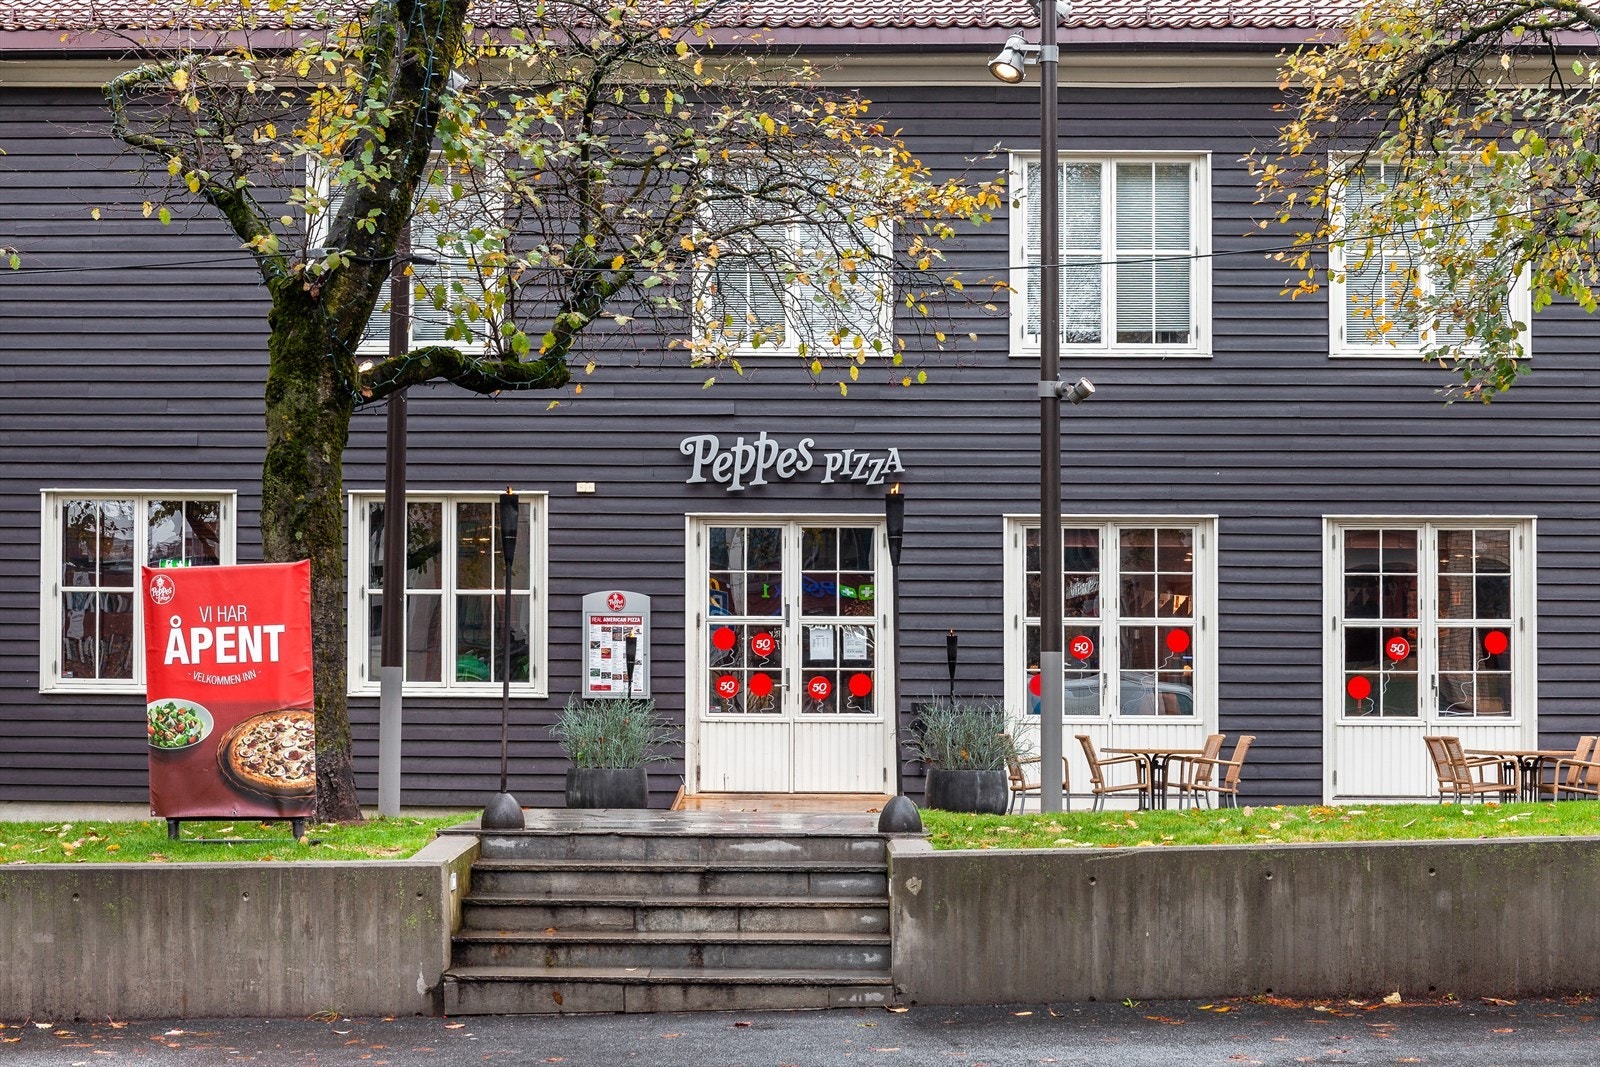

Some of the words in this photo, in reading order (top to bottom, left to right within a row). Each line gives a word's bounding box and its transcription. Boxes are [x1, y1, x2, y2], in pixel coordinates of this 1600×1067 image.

[679, 431, 815, 492] Peppes
[821, 447, 906, 486] PIZZA
[199, 606, 213, 623] VI
[217, 604, 248, 623] HAR
[163, 614, 286, 665] ÅPENT
[756, 638, 771, 649] 50
[1073, 641, 1089, 652] 50
[1390, 643, 1405, 653] 50
[192, 670, 242, 685] VELKOMMEN
[242, 669, 257, 682] INN
[719, 680, 735, 691] 50
[812, 682, 827, 692] 50
